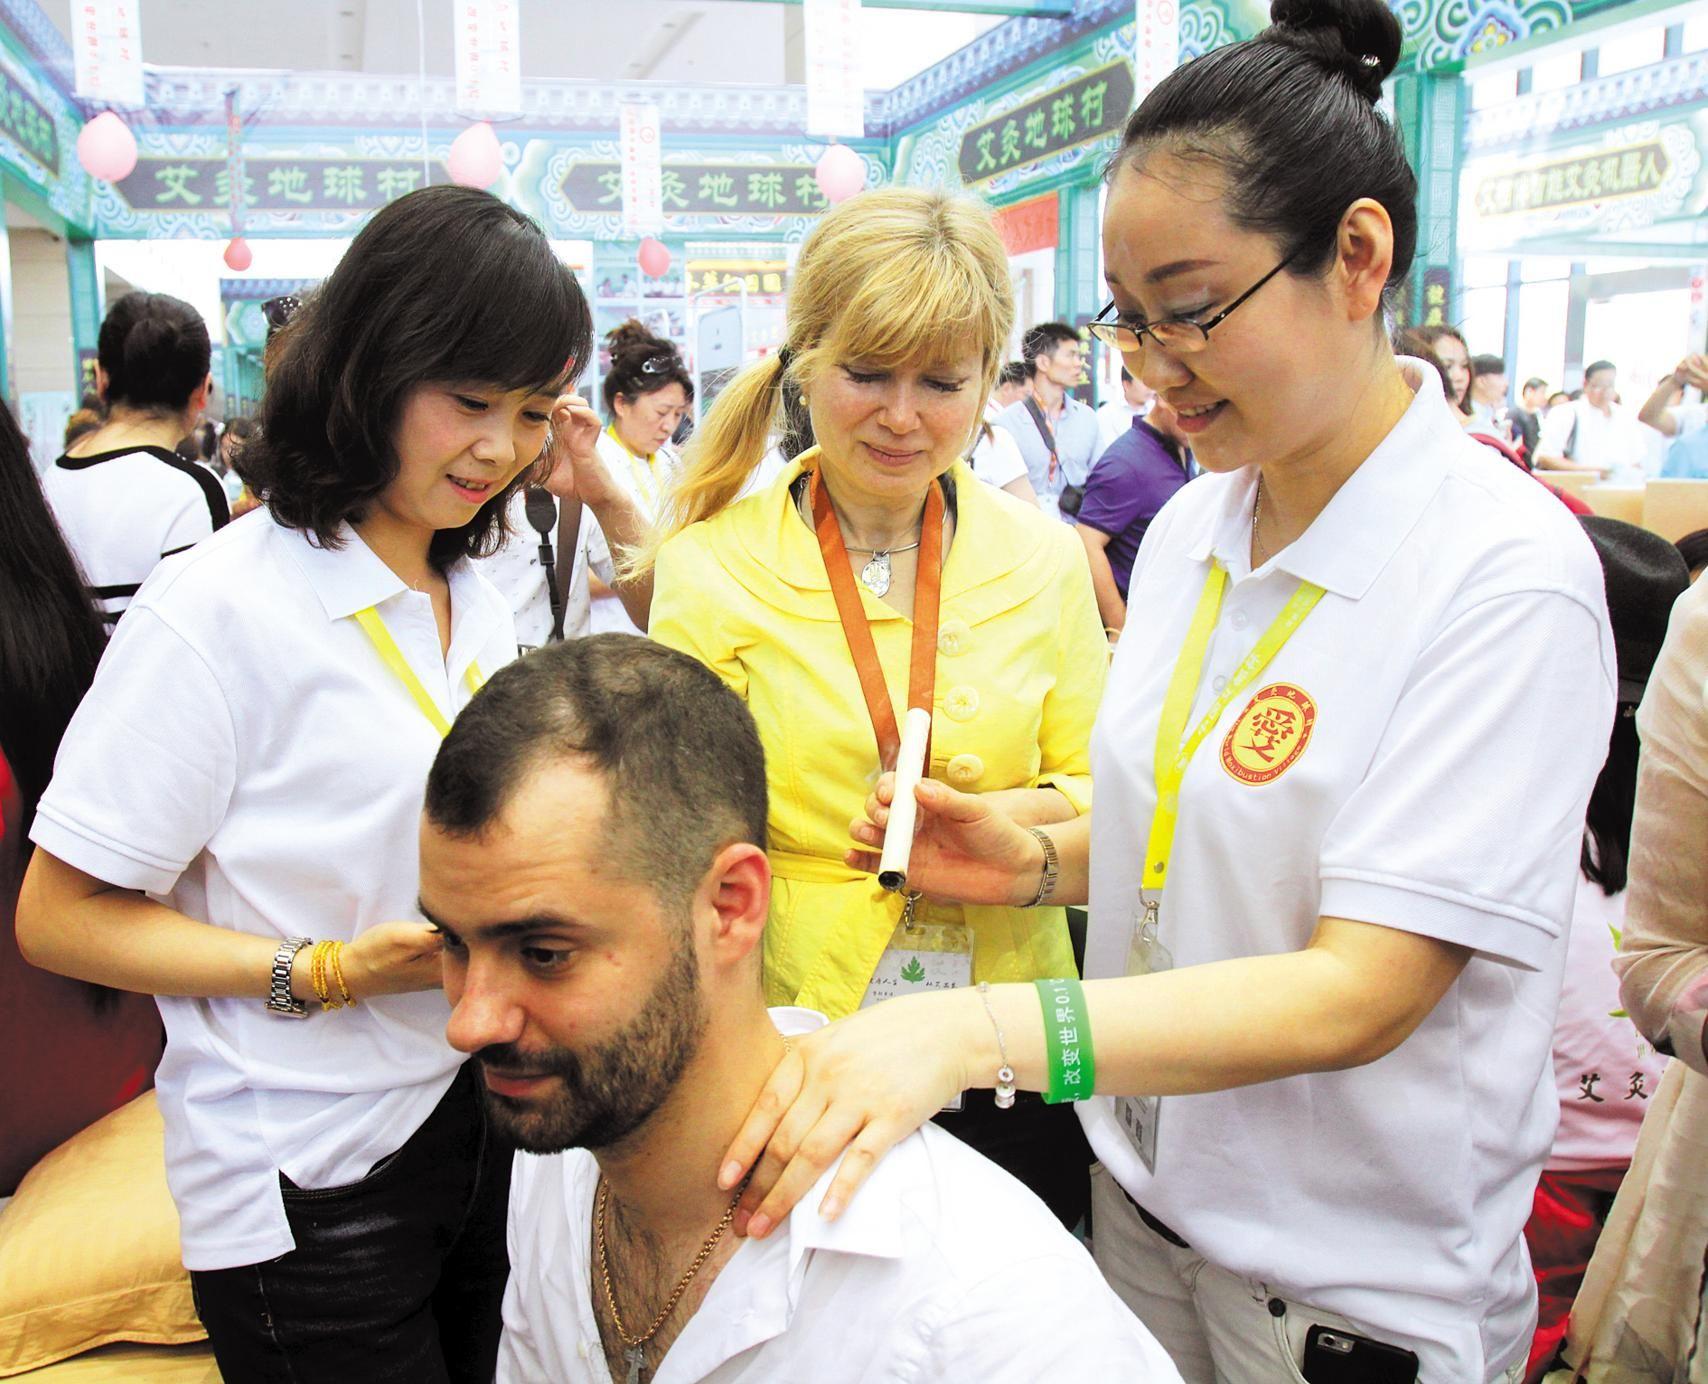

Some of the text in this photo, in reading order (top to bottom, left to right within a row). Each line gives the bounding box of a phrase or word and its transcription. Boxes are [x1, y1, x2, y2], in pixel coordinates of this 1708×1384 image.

[976, 80, 1108, 172] 艾灸地球村
[1224, 755, 1272, 781] Moxibustion
[1578, 1072, 1648, 1102] 艾灸
